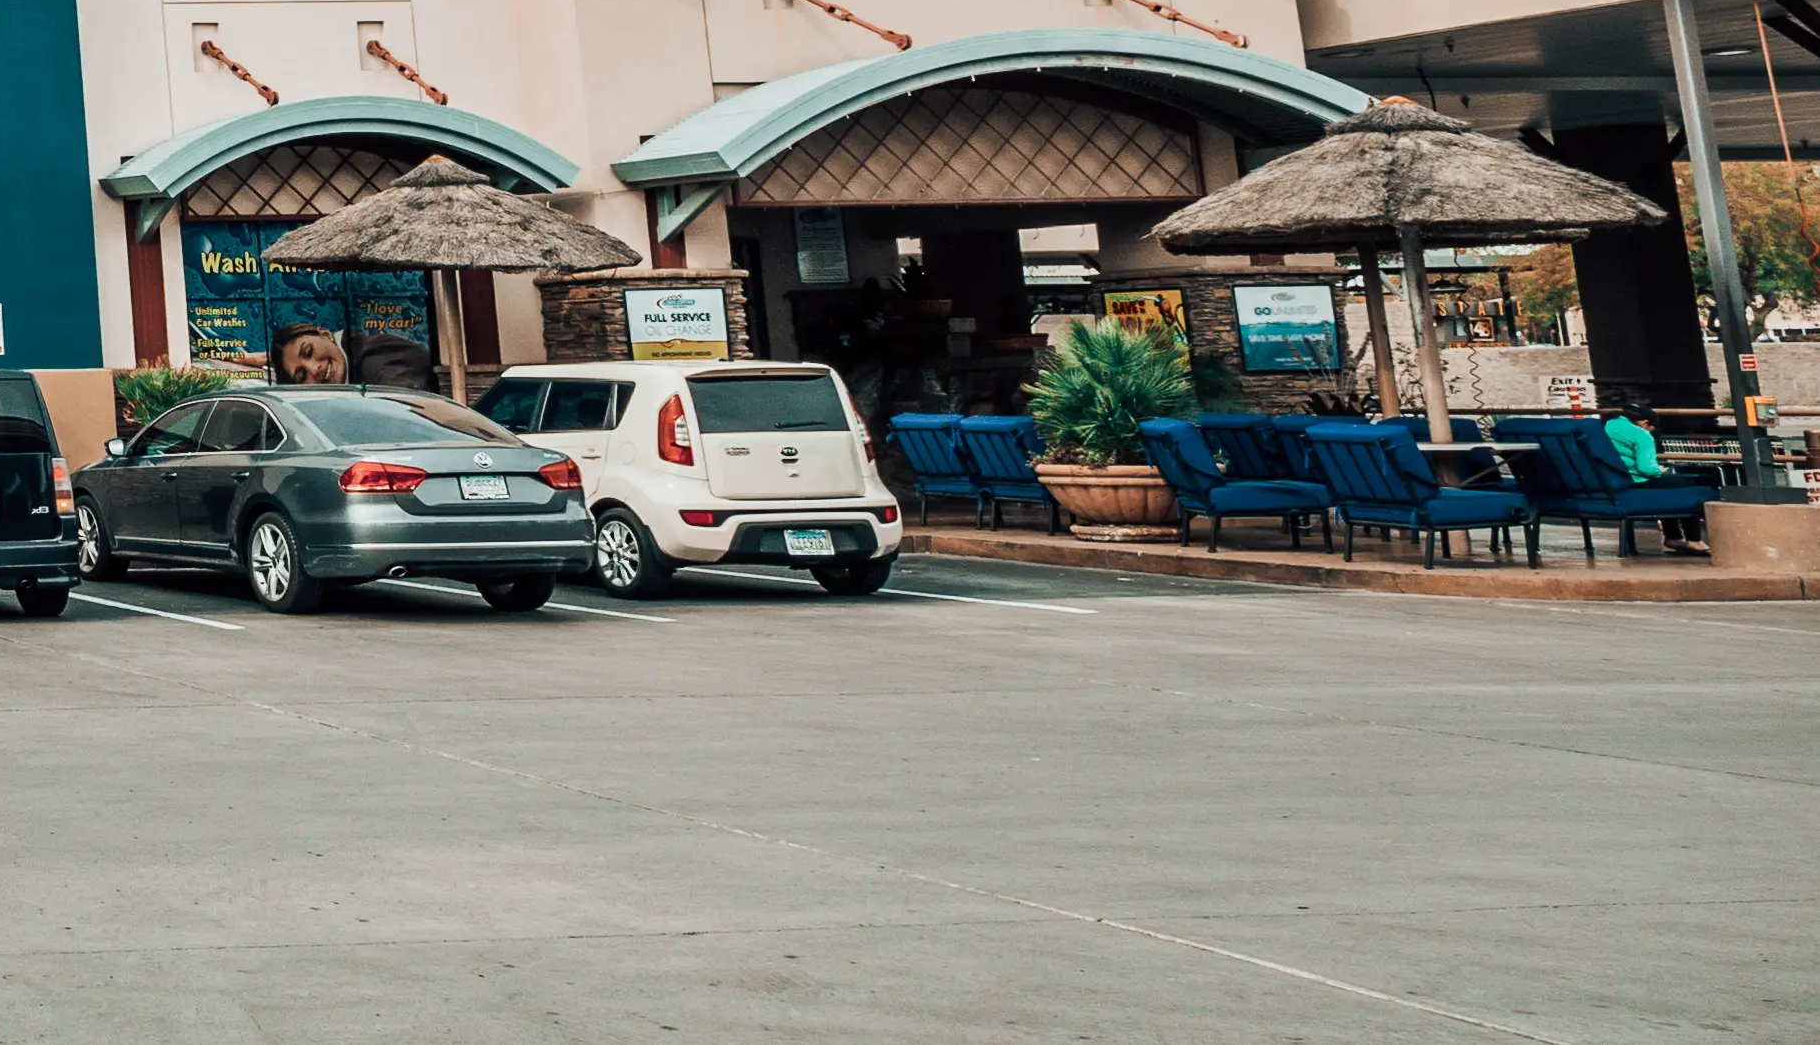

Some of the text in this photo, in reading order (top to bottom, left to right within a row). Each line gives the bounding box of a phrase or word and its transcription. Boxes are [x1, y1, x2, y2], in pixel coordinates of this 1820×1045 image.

[201, 252, 257, 274] Wash
[195, 307, 237, 315] Unlimited
[373, 303, 403, 314] love
[197, 317, 247, 327] Car Washes
[644, 312, 711, 323] FULL SERVICE
[364, 320, 385, 332] my
[665, 324, 712, 336] CHANGE
